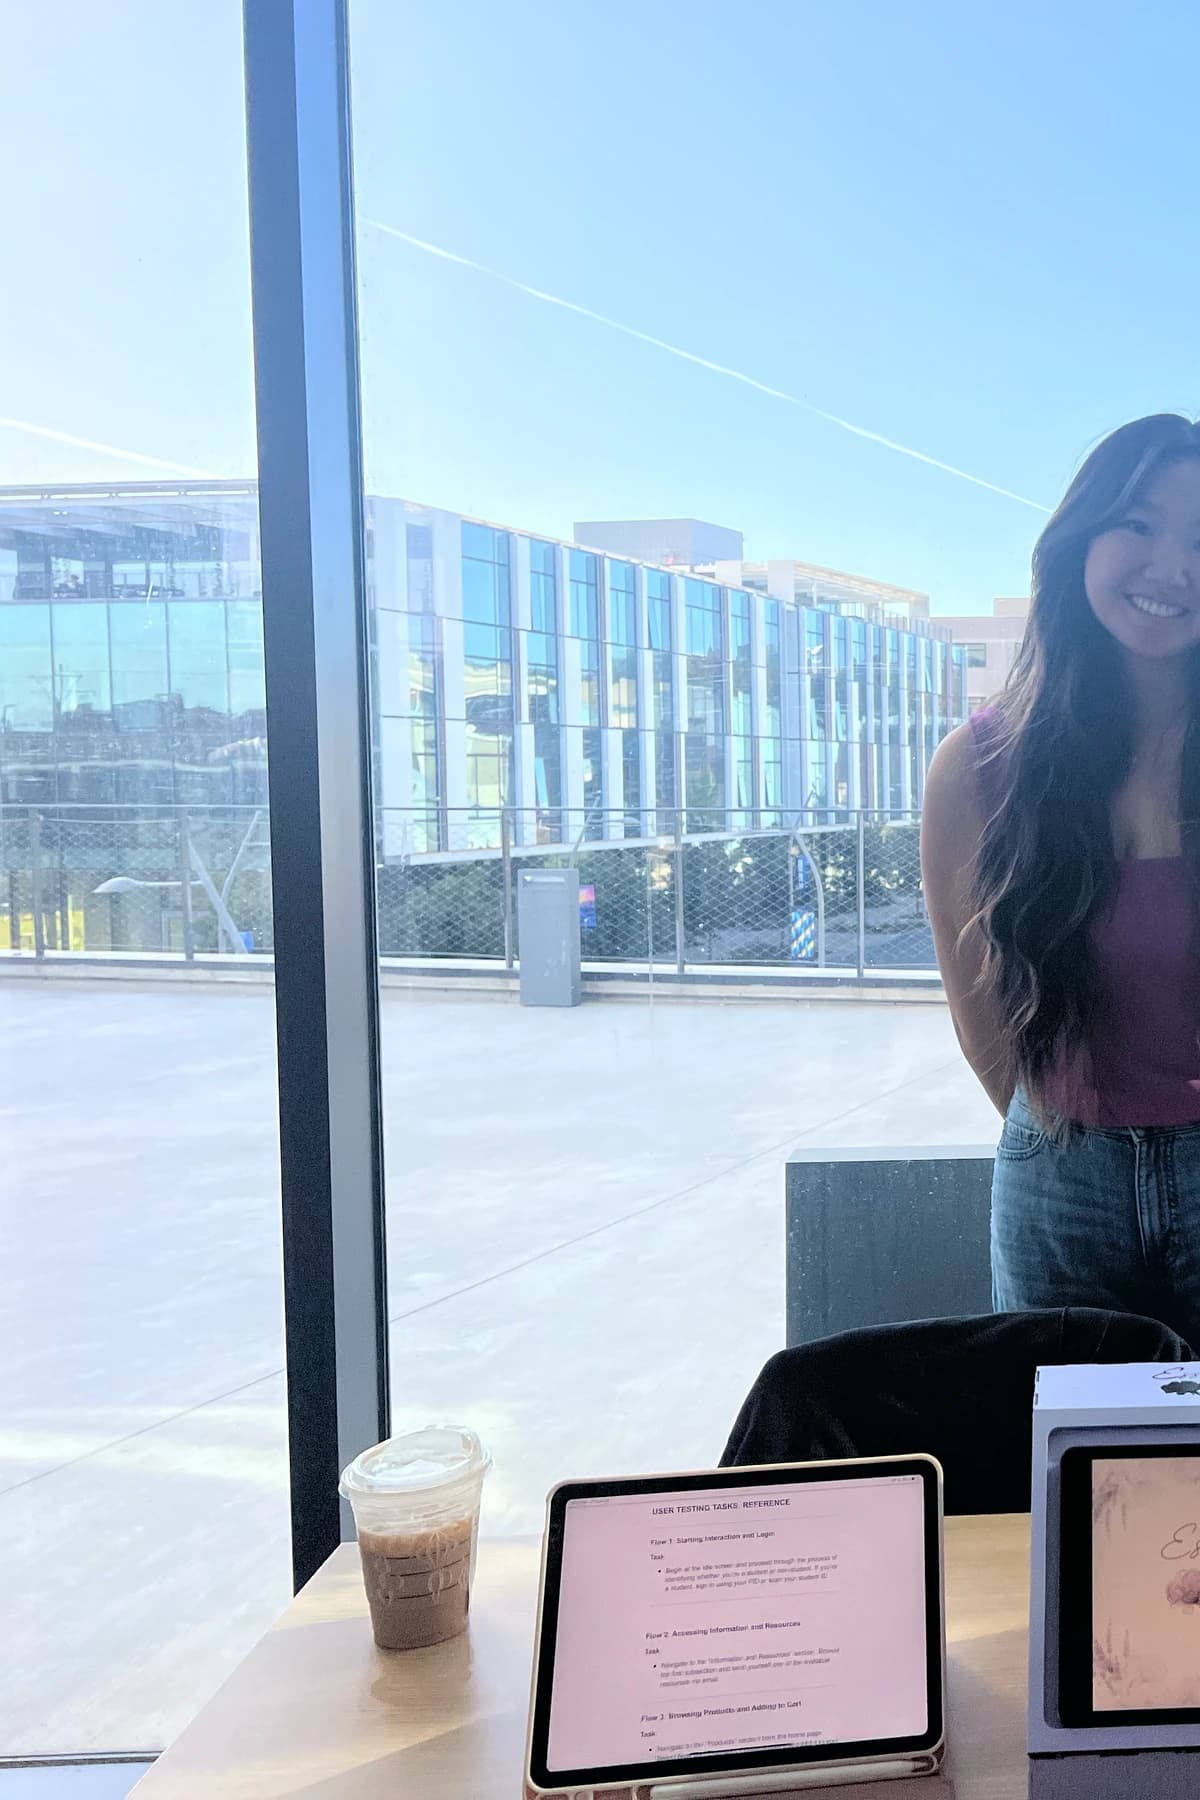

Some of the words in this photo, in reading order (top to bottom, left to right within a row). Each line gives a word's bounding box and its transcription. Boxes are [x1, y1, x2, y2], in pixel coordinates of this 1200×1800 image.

[652, 1506, 674, 1515] USER
[676, 1504, 710, 1513] TESTING
[742, 1499, 791, 1509] REFERENCE
[676, 1536, 703, 1545] Starting
[705, 1534, 741, 1542] Interaction
[757, 1532, 775, 1541] Login
[646, 1631, 663, 1639] Flow
[672, 1628, 708, 1639] Accessing
[709, 1625, 749, 1634] Information
[765, 1621, 801, 1630] Resources
[641, 1713, 658, 1722] Flow
[668, 1709, 702, 1721] Browsing
[703, 1706, 735, 1716] Products
[737, 1705, 751, 1713] and
[752, 1703, 777, 1713] Adding
[787, 1700, 802, 1709] Cart
